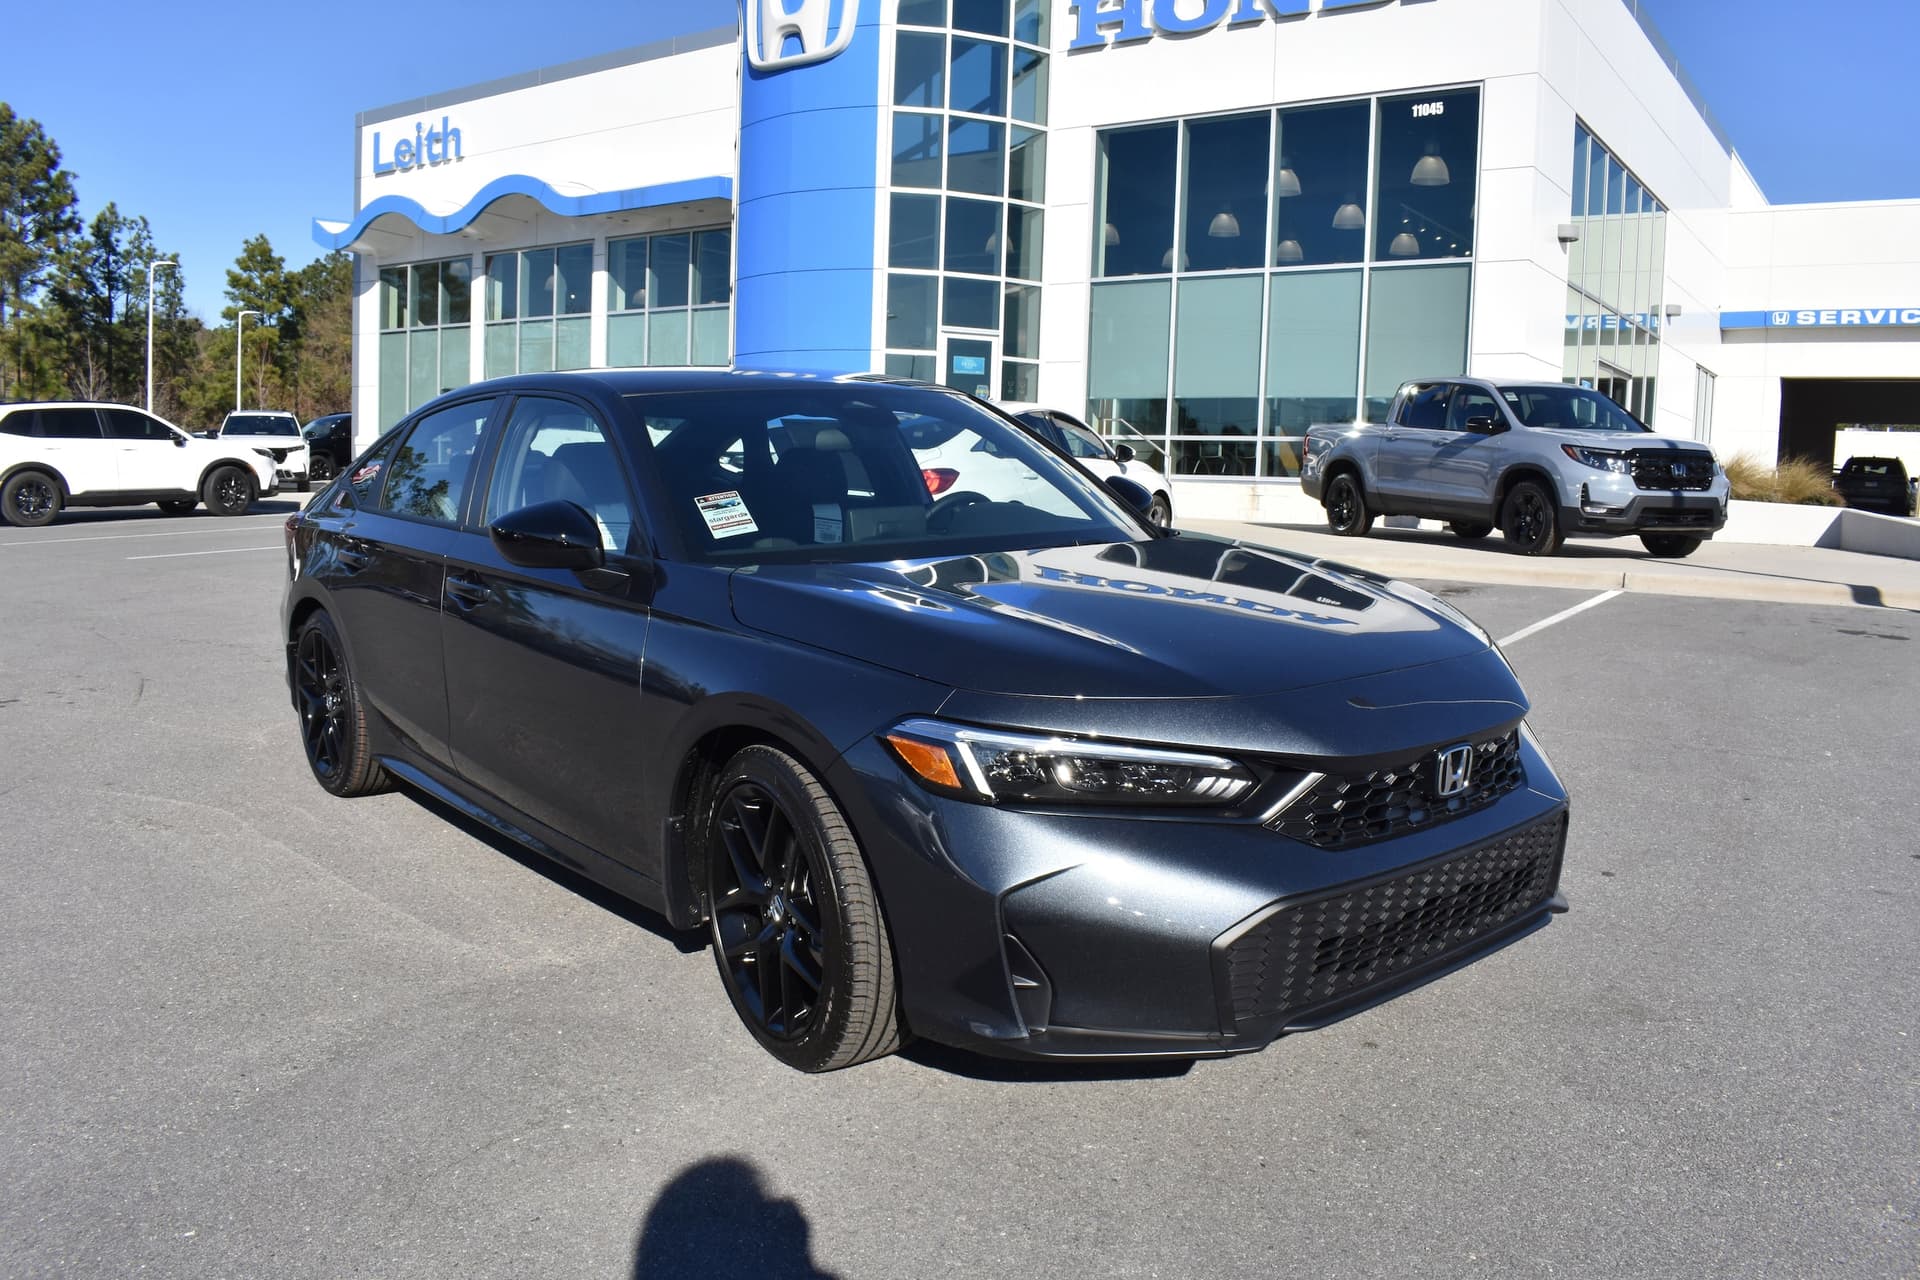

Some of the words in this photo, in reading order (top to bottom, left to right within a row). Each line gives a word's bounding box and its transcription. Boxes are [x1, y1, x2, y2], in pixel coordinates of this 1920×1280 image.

[1412, 101, 1444, 118] 11045
[373, 115, 463, 174] Leith
[1796, 309, 1920, 326] SERVIC
